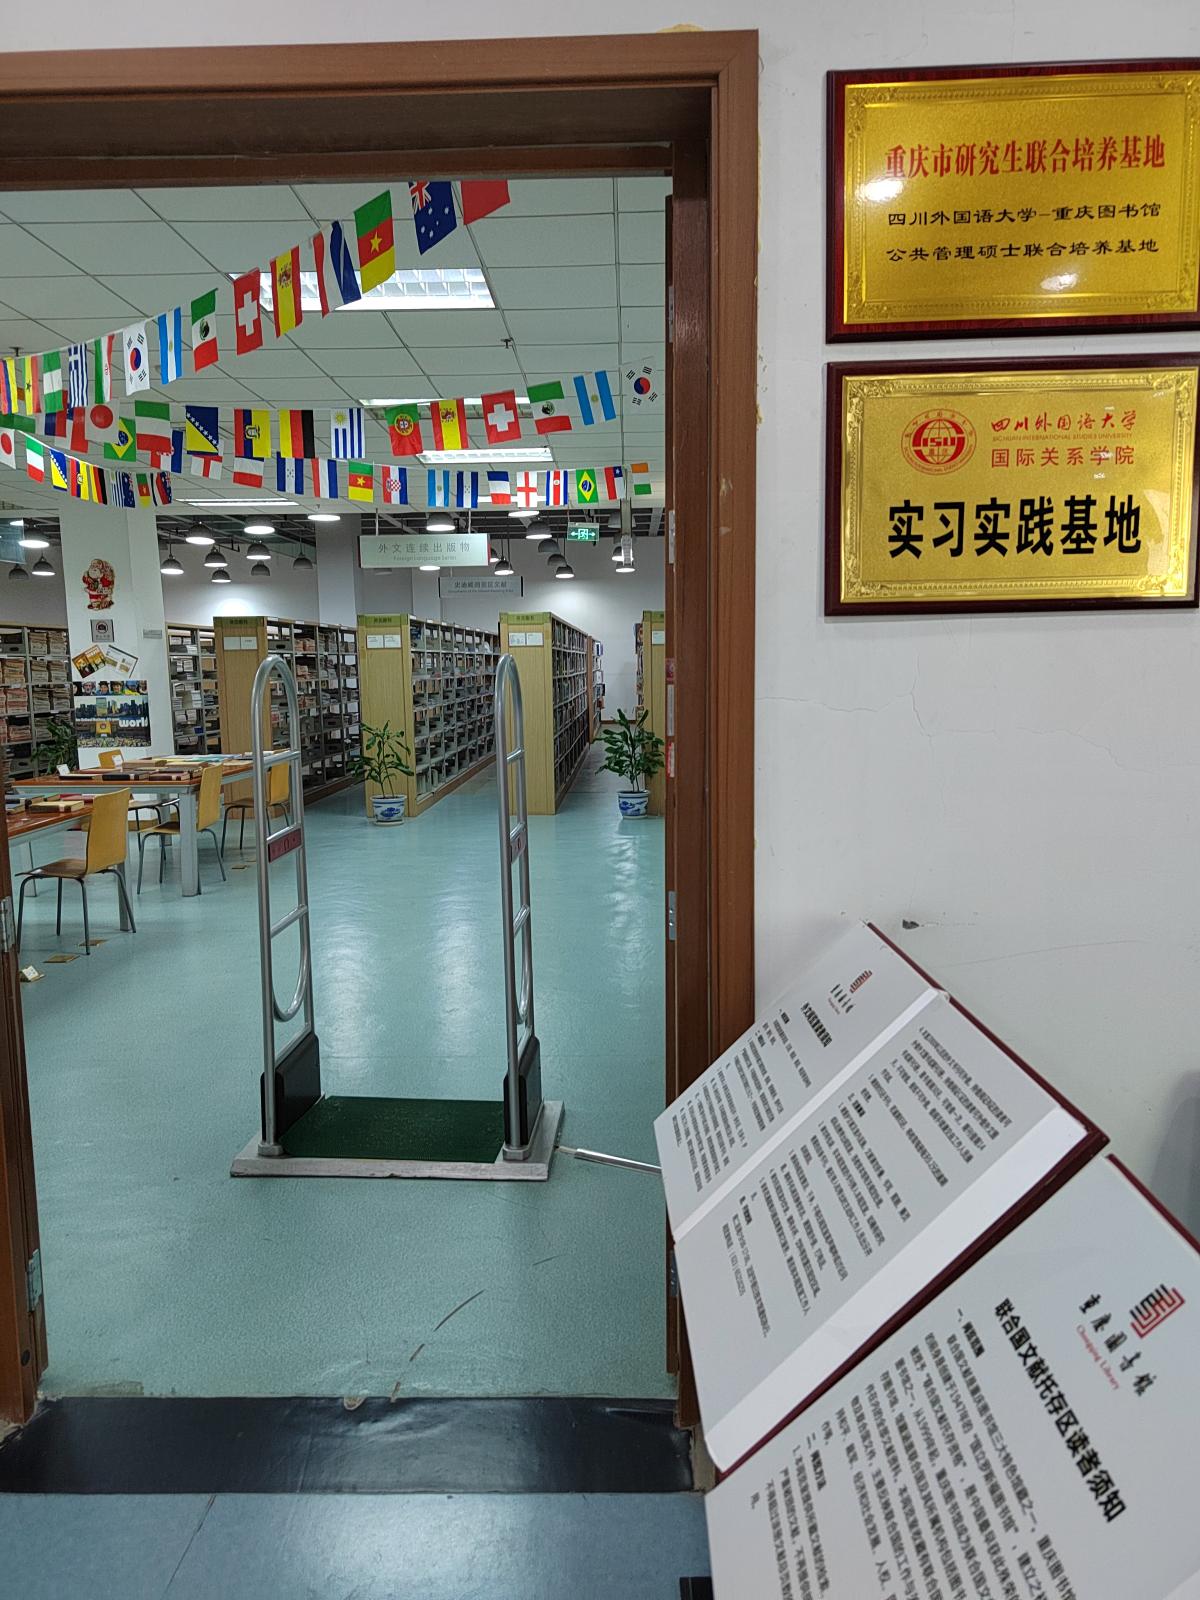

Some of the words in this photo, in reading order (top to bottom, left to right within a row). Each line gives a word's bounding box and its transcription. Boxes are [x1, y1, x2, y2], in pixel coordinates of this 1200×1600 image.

[885, 135, 1165, 178] 重庆市研究生联合培养基地
[886, 239, 1159, 262] 公共管理硕士联合培养基地
[991, 410, 1136, 432] 四川外国语大学
[991, 446, 1135, 468] 国际关系学院
[887, 494, 1142, 559] 实习实践基地
[378, 541, 470, 554] 外文连续出版物
[1076, 1324, 1103, 1363] Chongqing
[1099, 1360, 1120, 1391] Library
[994, 1297, 1127, 1523] 联合国文献托存区读者须知
